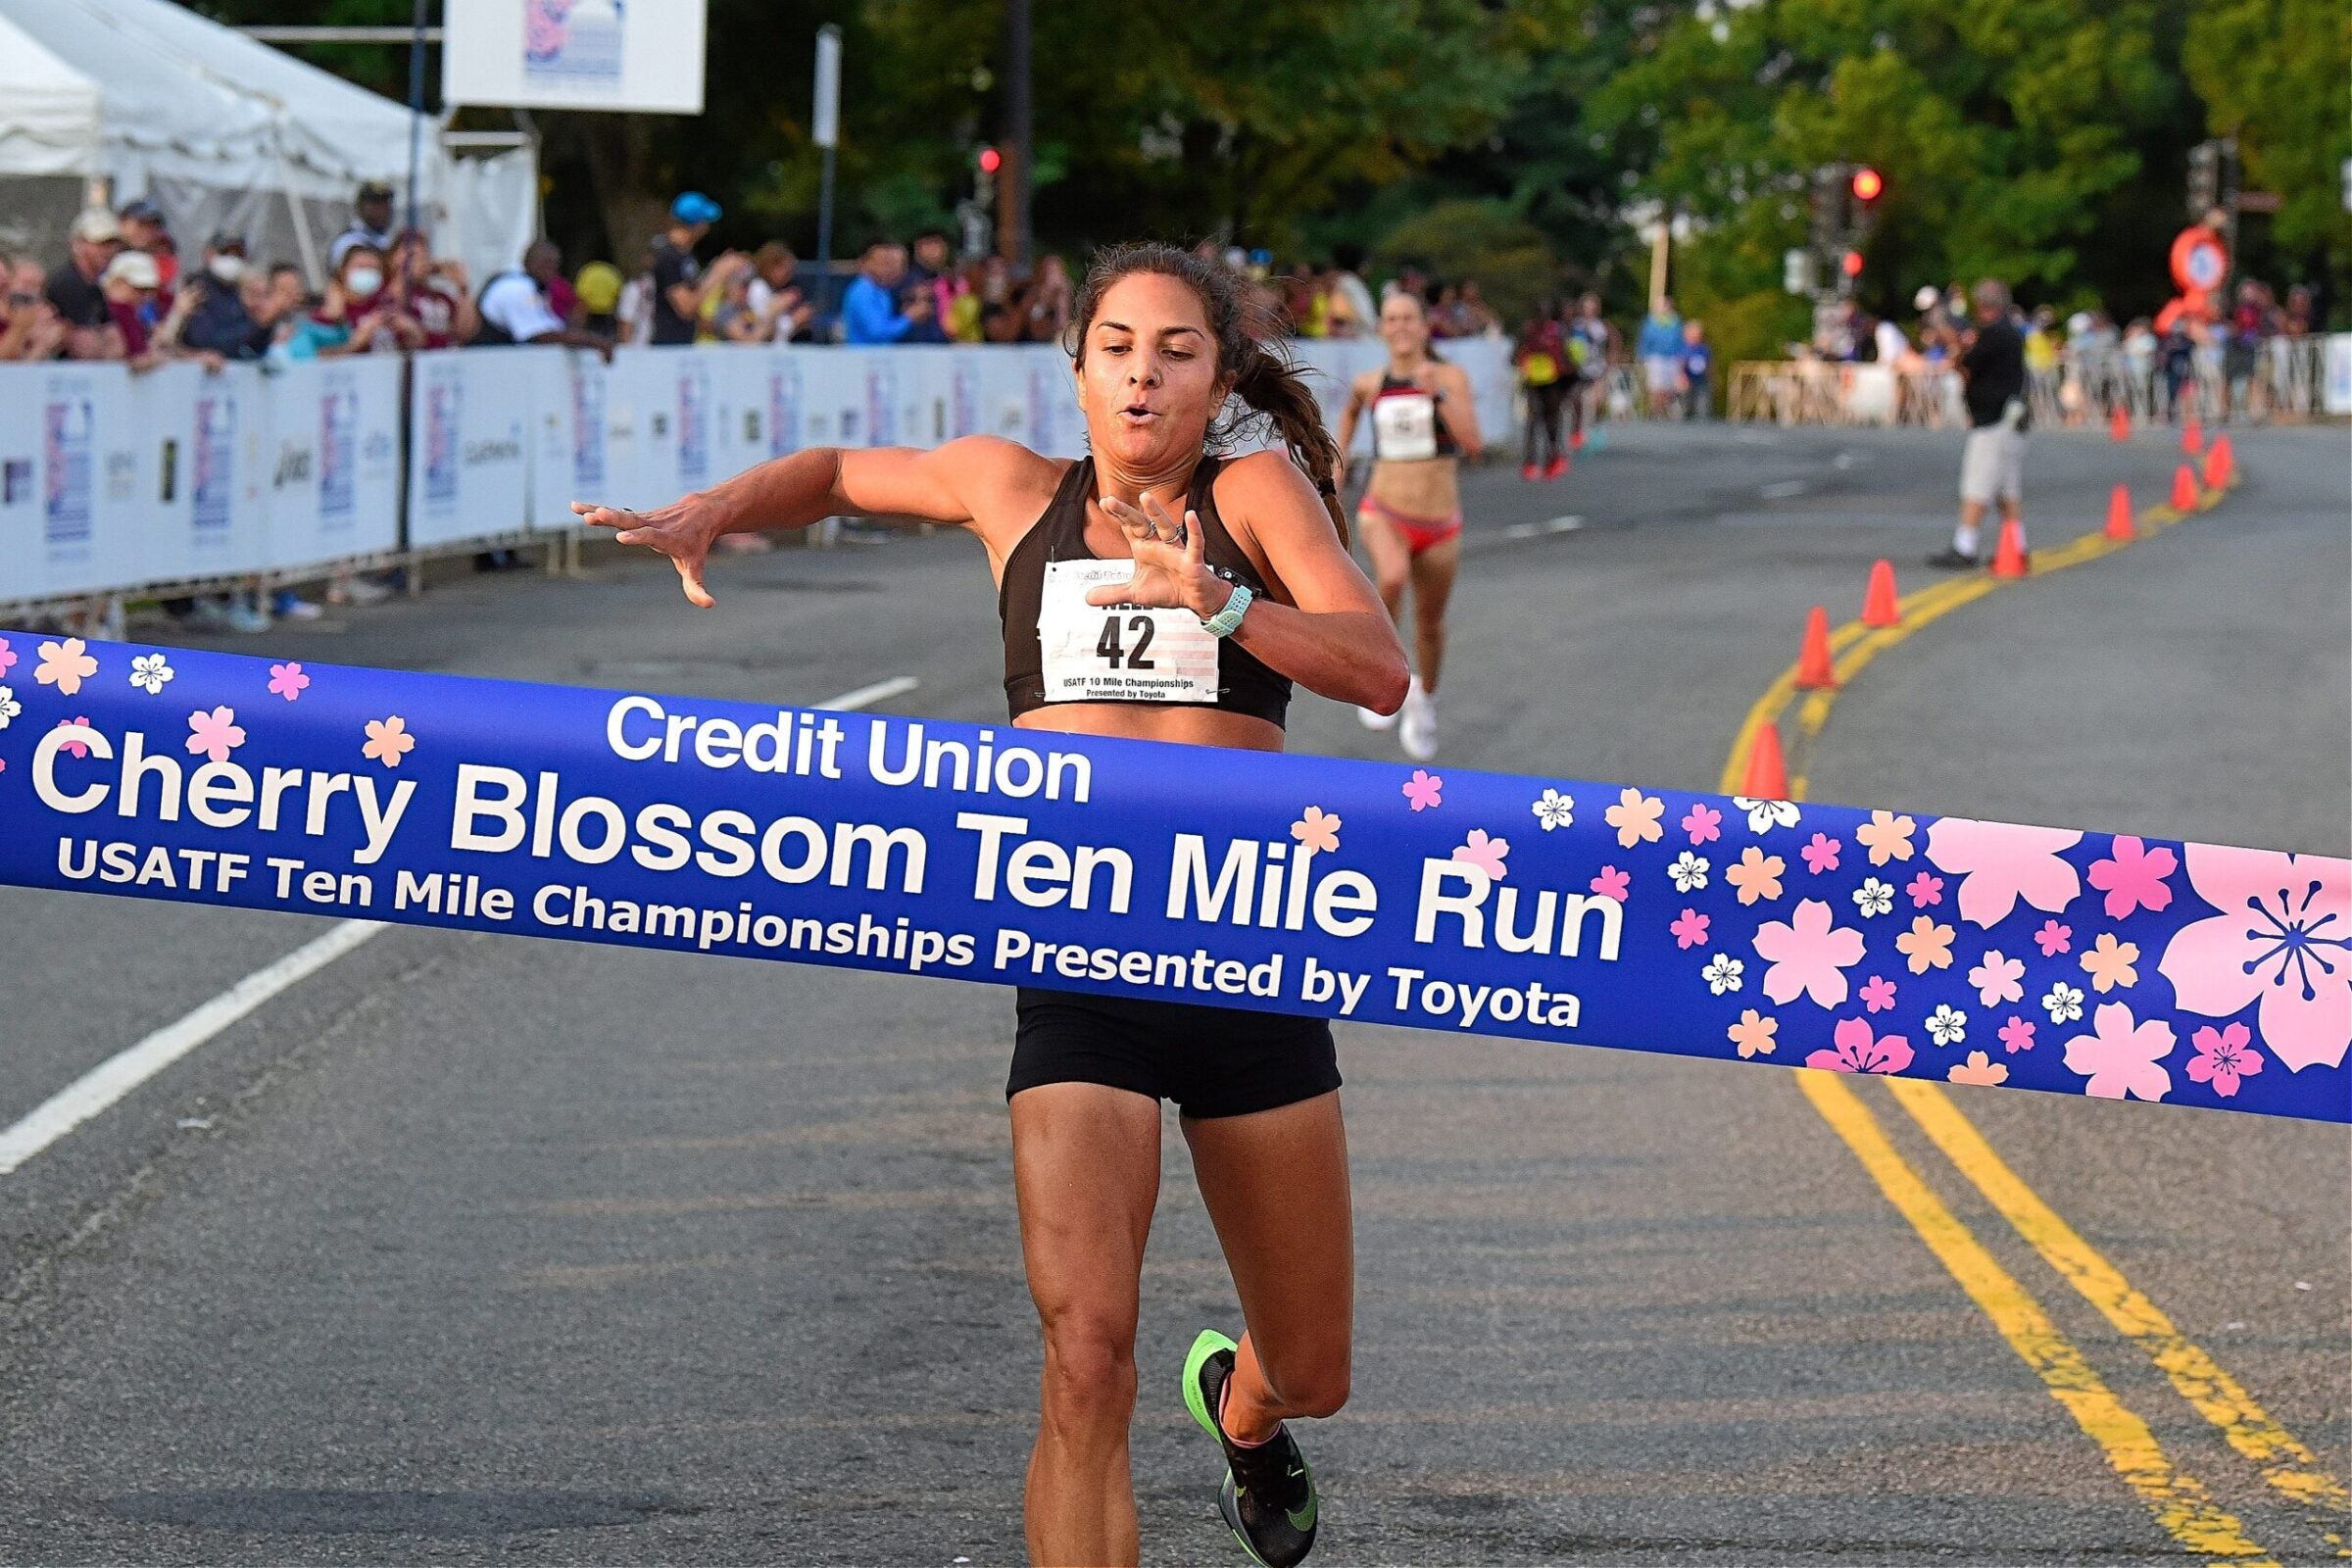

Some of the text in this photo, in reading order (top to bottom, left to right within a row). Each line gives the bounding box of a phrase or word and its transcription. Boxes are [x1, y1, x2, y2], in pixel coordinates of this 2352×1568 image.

[1097, 615, 1154, 669] 42
[1063, 678, 1086, 687] USATF
[1103, 678, 1122, 687] Mile
[1125, 678, 1194, 689] Championships
[1086, 689, 1165, 699] Presented by Toyota
[607, 696, 1091, 803] Credit Union
[31, 723, 1624, 962] Cherry Blossom Ten Mile Run
[58, 837, 1581, 1028] USATF Ten Mile Championships Presented by Toyota
